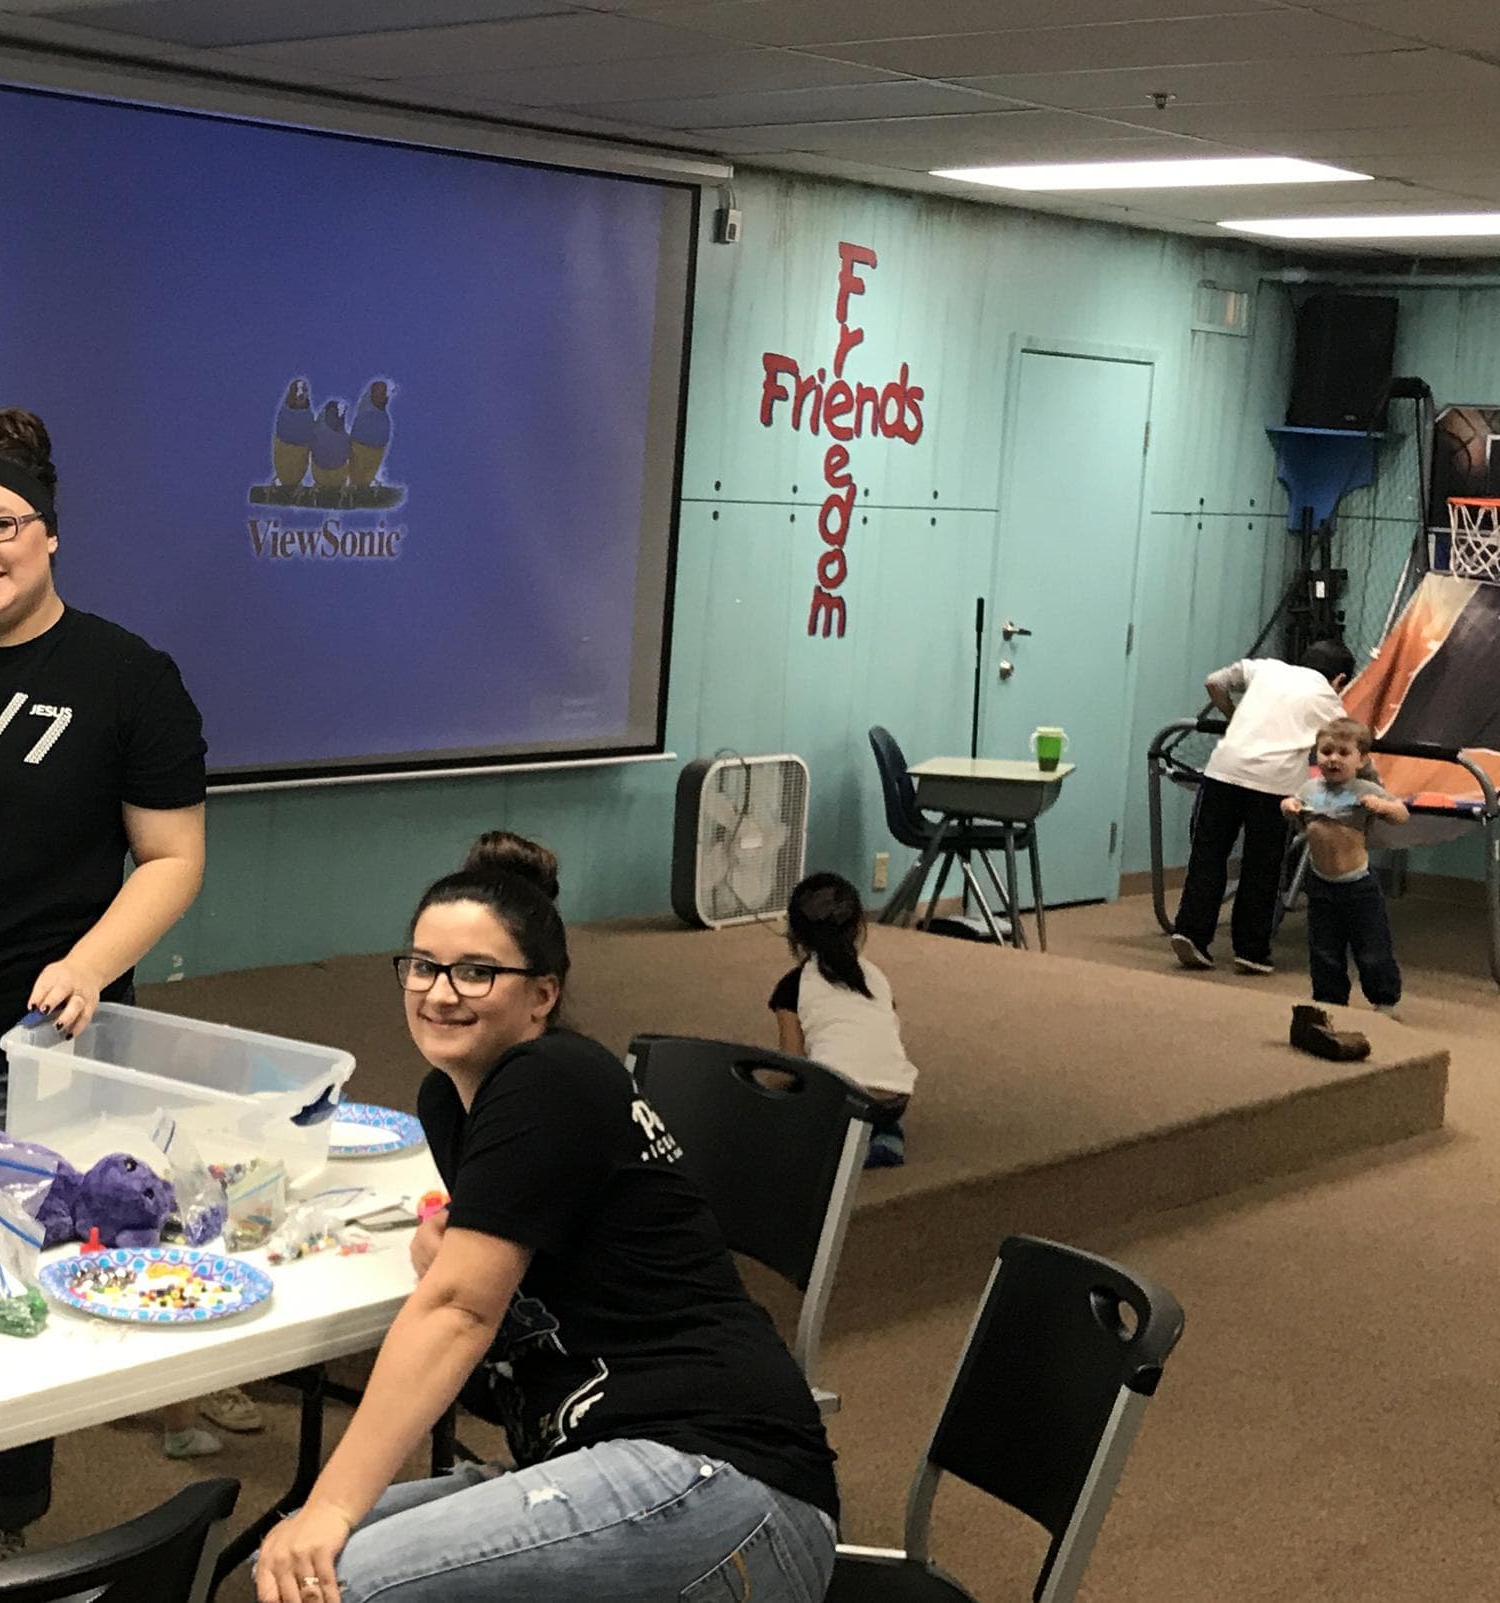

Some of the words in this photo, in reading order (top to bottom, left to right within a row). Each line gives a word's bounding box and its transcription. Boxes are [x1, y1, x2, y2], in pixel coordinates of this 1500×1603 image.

[760, 352, 924, 445] Friends
[247, 518, 402, 560] ViewSonic
[28, 704, 73, 719] JESUS
